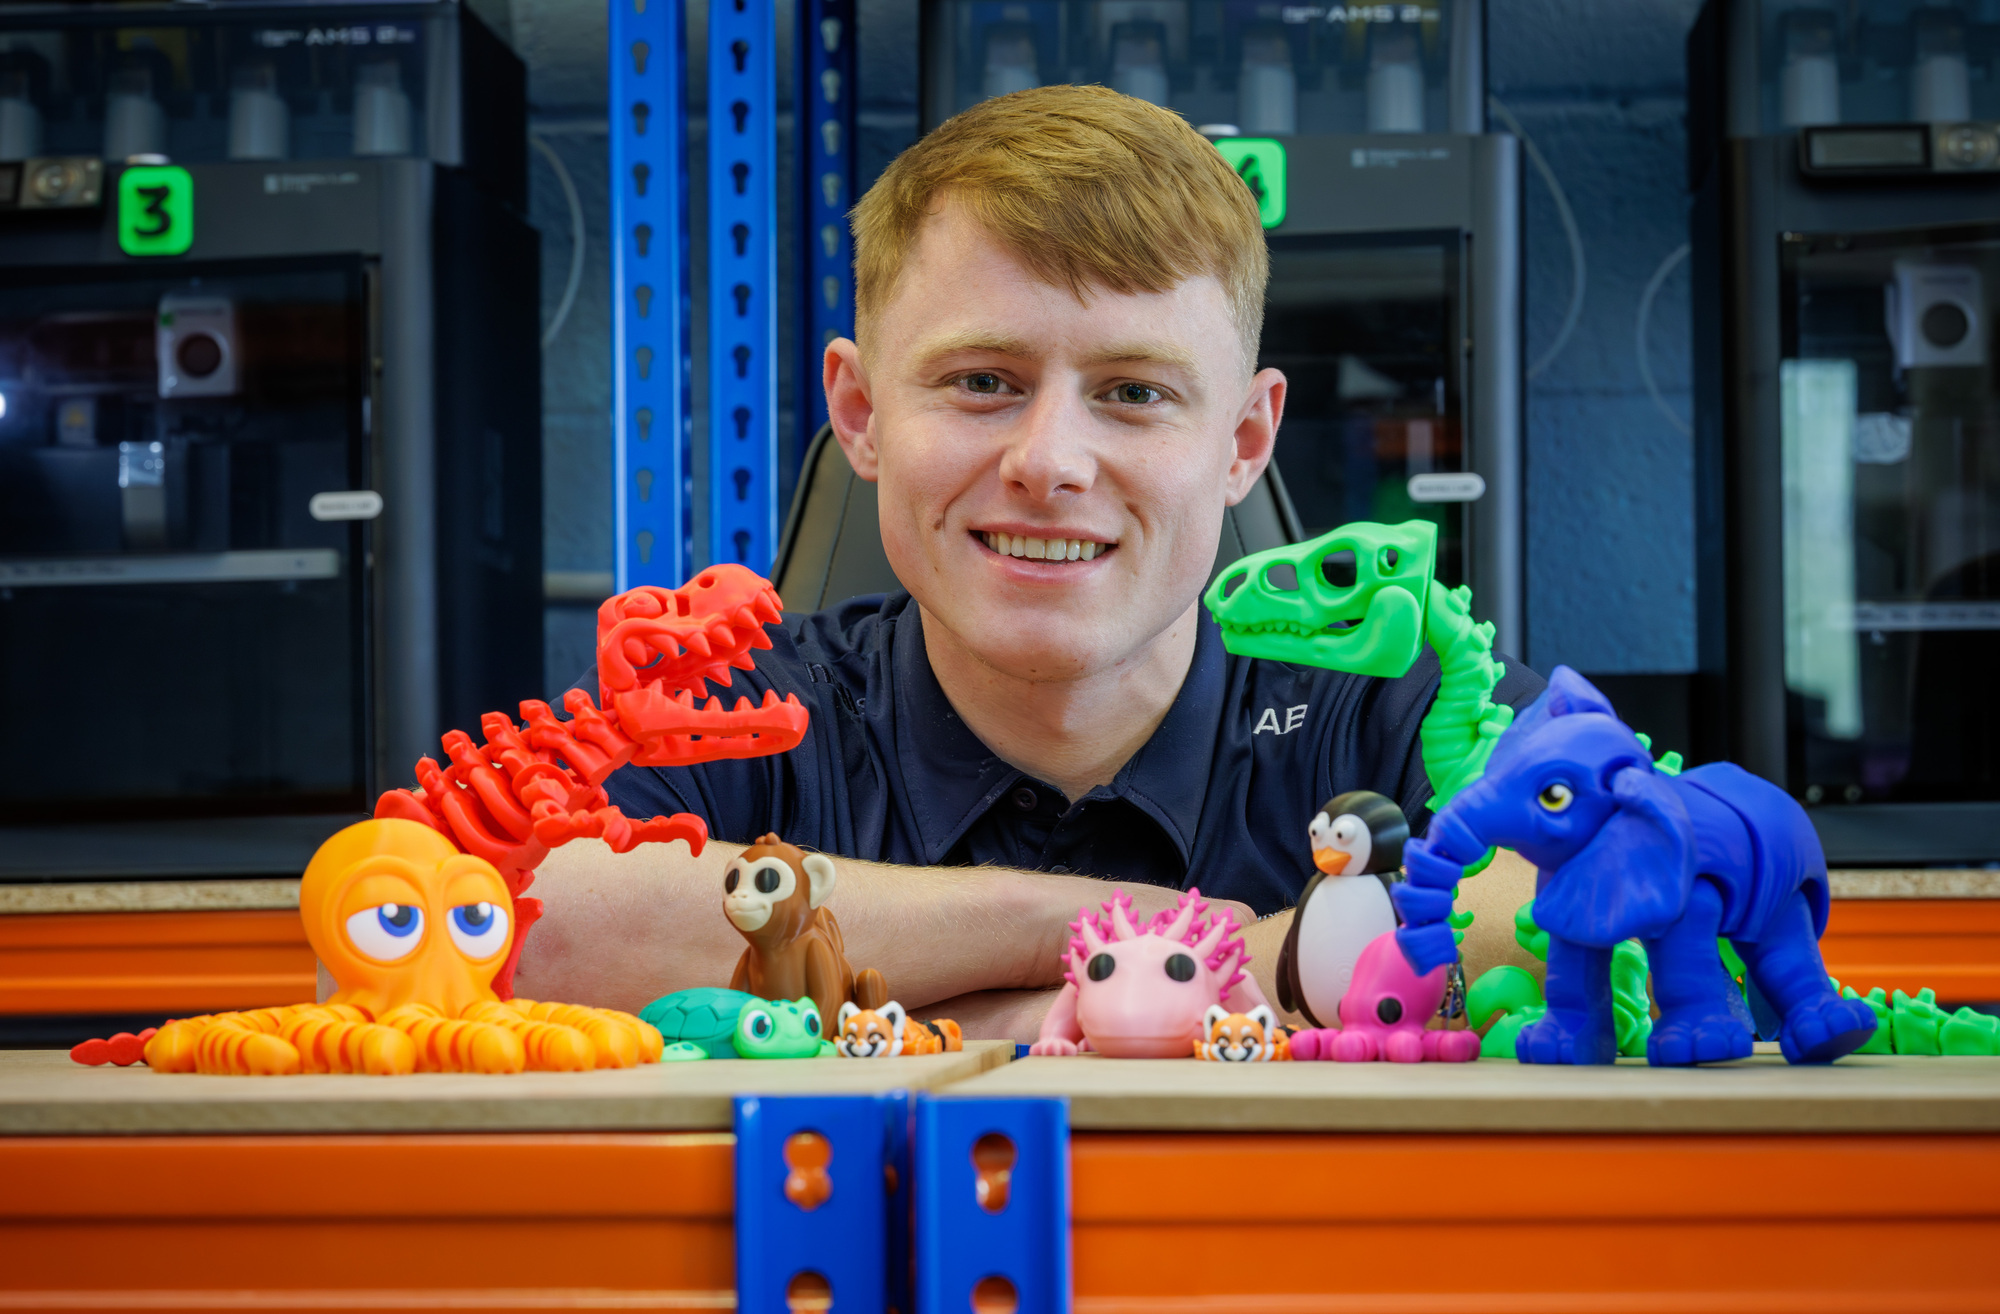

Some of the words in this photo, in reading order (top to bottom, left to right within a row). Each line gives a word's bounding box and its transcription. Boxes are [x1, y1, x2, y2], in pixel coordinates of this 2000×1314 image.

[1326, 4, 1395, 24] AMS
[304, 26, 372, 46] AMS
[134, 185, 172, 237] 3
